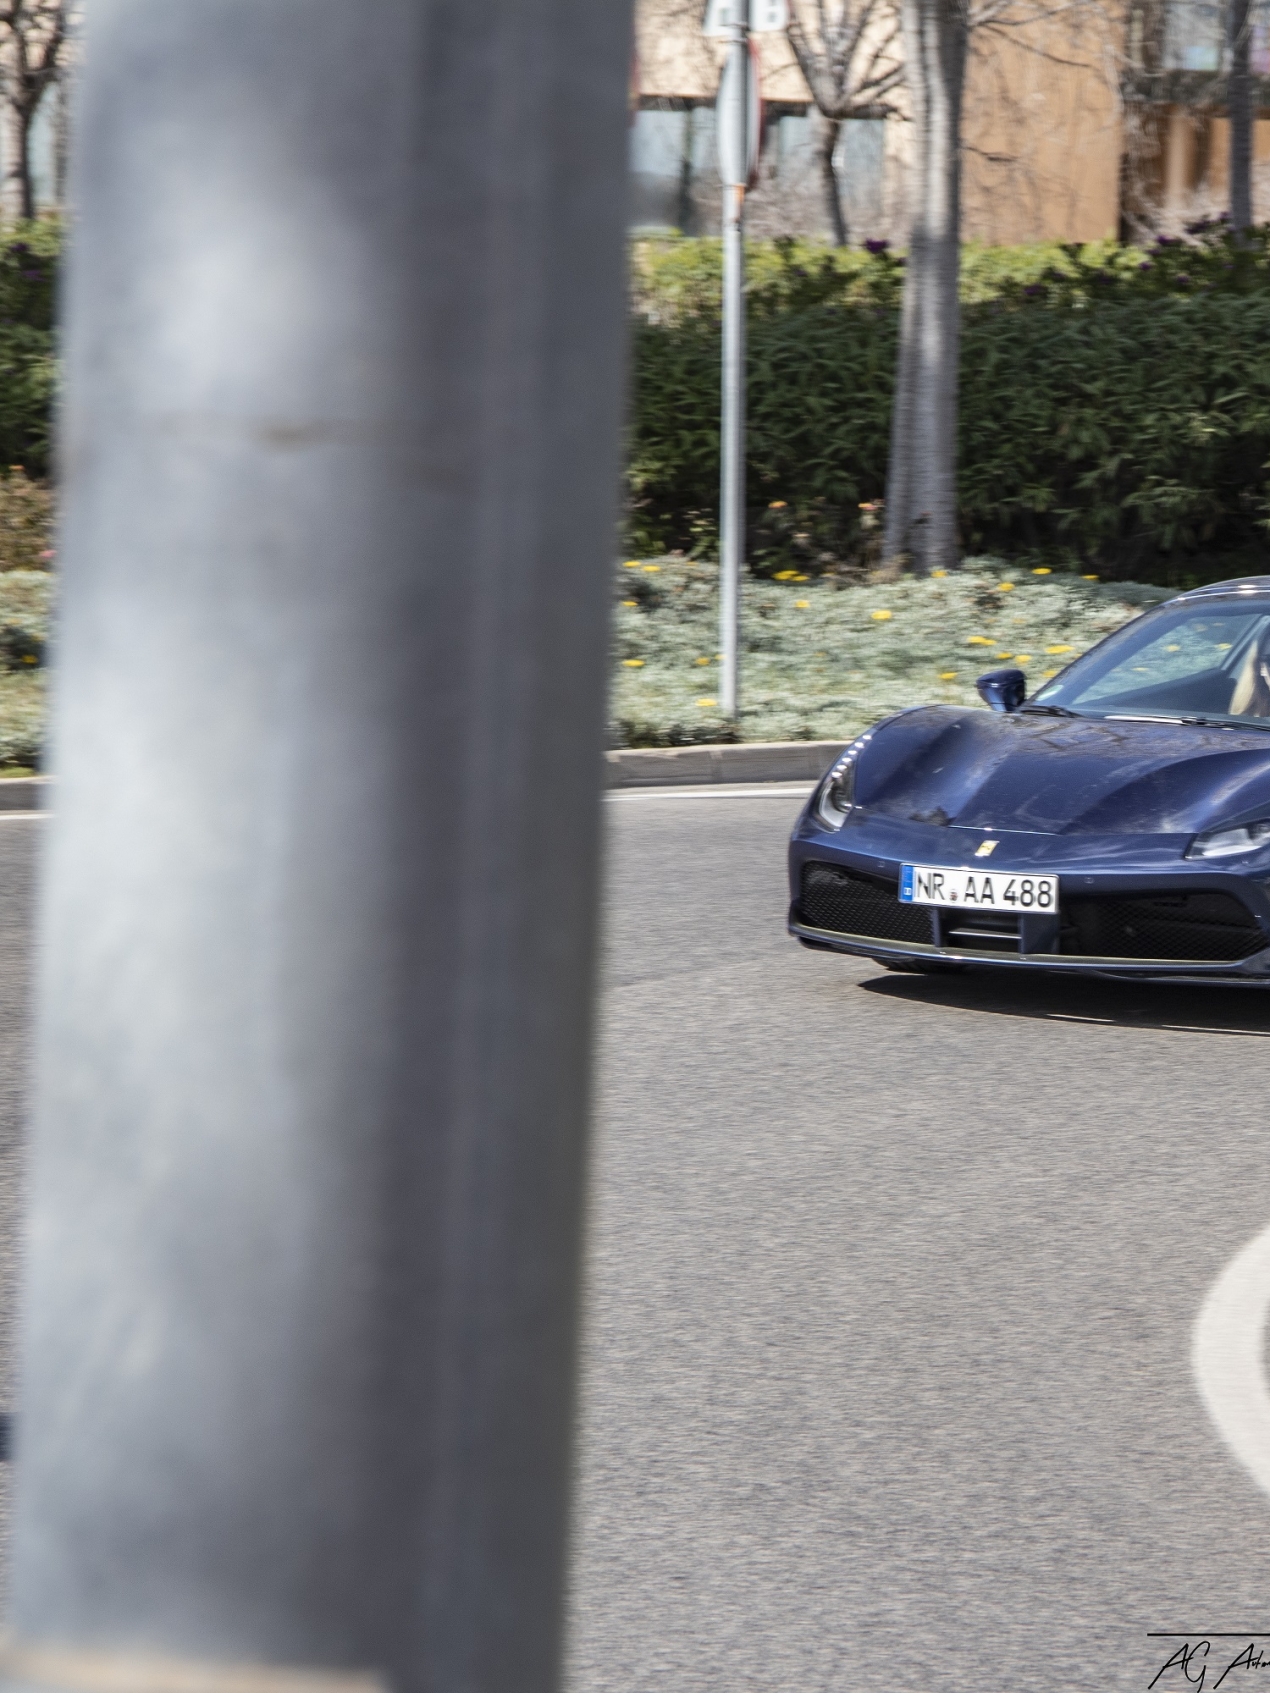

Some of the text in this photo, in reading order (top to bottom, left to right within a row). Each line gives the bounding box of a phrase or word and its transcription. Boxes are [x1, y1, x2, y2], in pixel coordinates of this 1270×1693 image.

[917, 873, 1053, 908] NR AA 488
